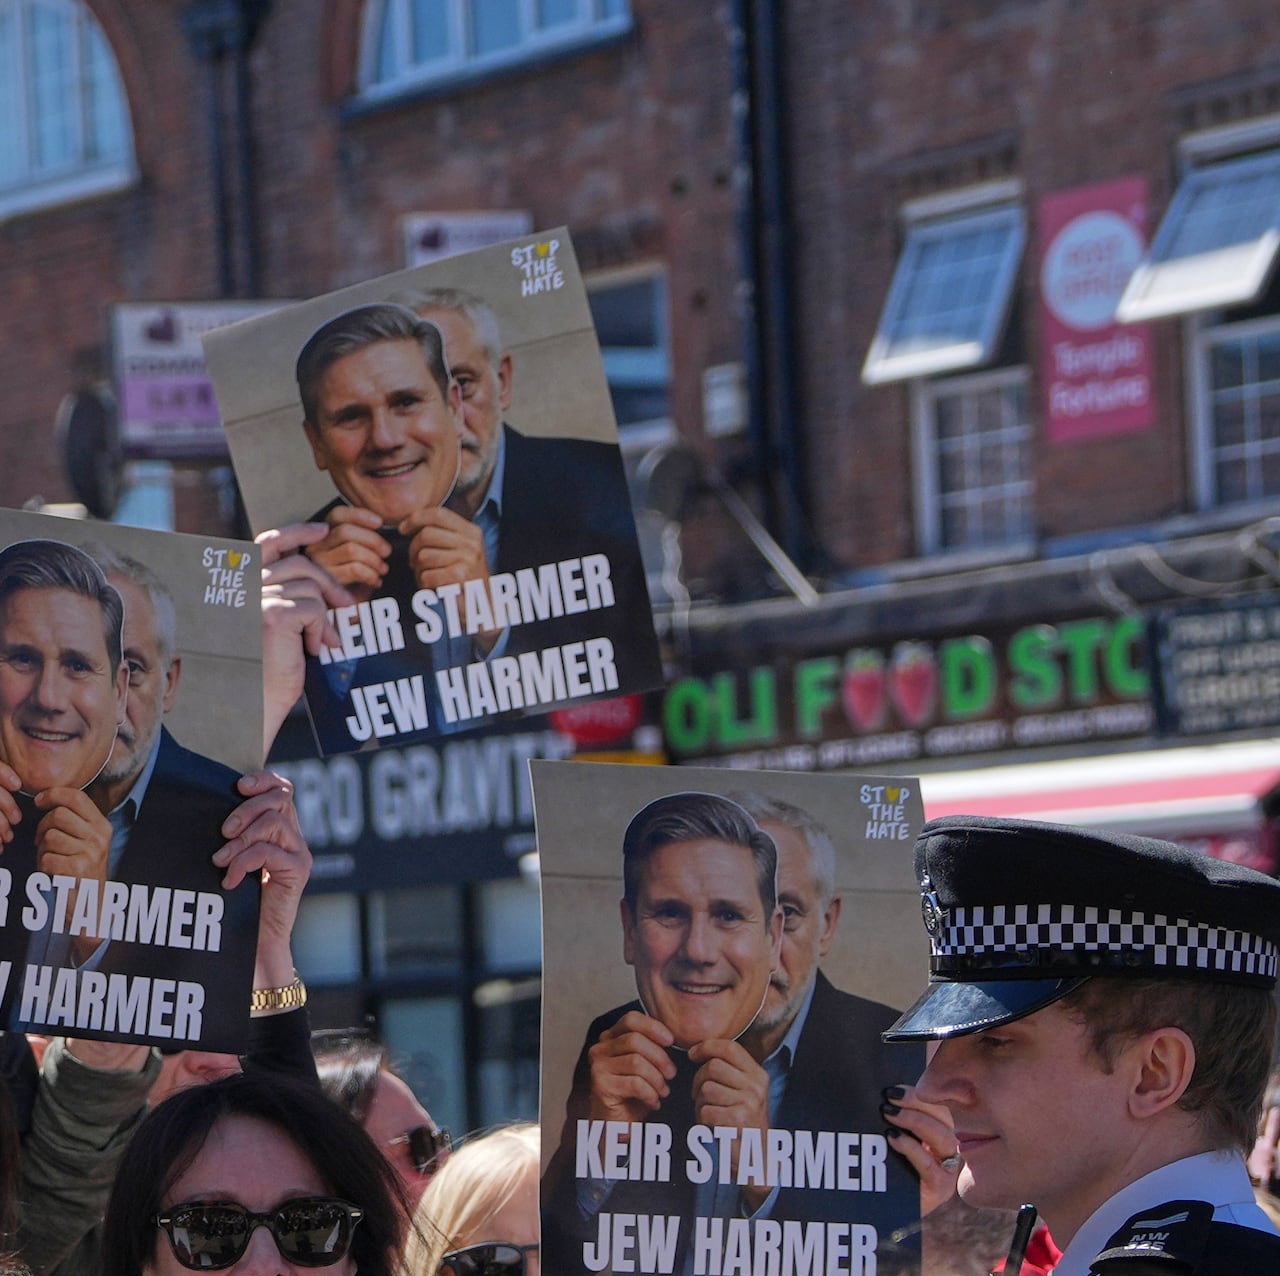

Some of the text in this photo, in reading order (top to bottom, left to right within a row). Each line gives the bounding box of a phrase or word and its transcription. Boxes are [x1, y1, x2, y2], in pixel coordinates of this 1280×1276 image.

[520, 257, 557, 279] THE
[520, 273, 564, 297] HATE
[204, 585, 247, 608] HATE
[208, 567, 244, 587] THE
[412, 554, 615, 644] STARMER
[345, 637, 619, 742] JEW HARMER
[664, 667, 776, 755] OLI
[278, 752, 363, 848] RO
[865, 820, 910, 841] HATE
[868, 802, 905, 823] THE
[21, 872, 225, 953] STARMER
[19, 965, 206, 1042] HARMER
[575, 1120, 888, 1192] KEIR STARMER
[583, 1212, 680, 1275] JEW
